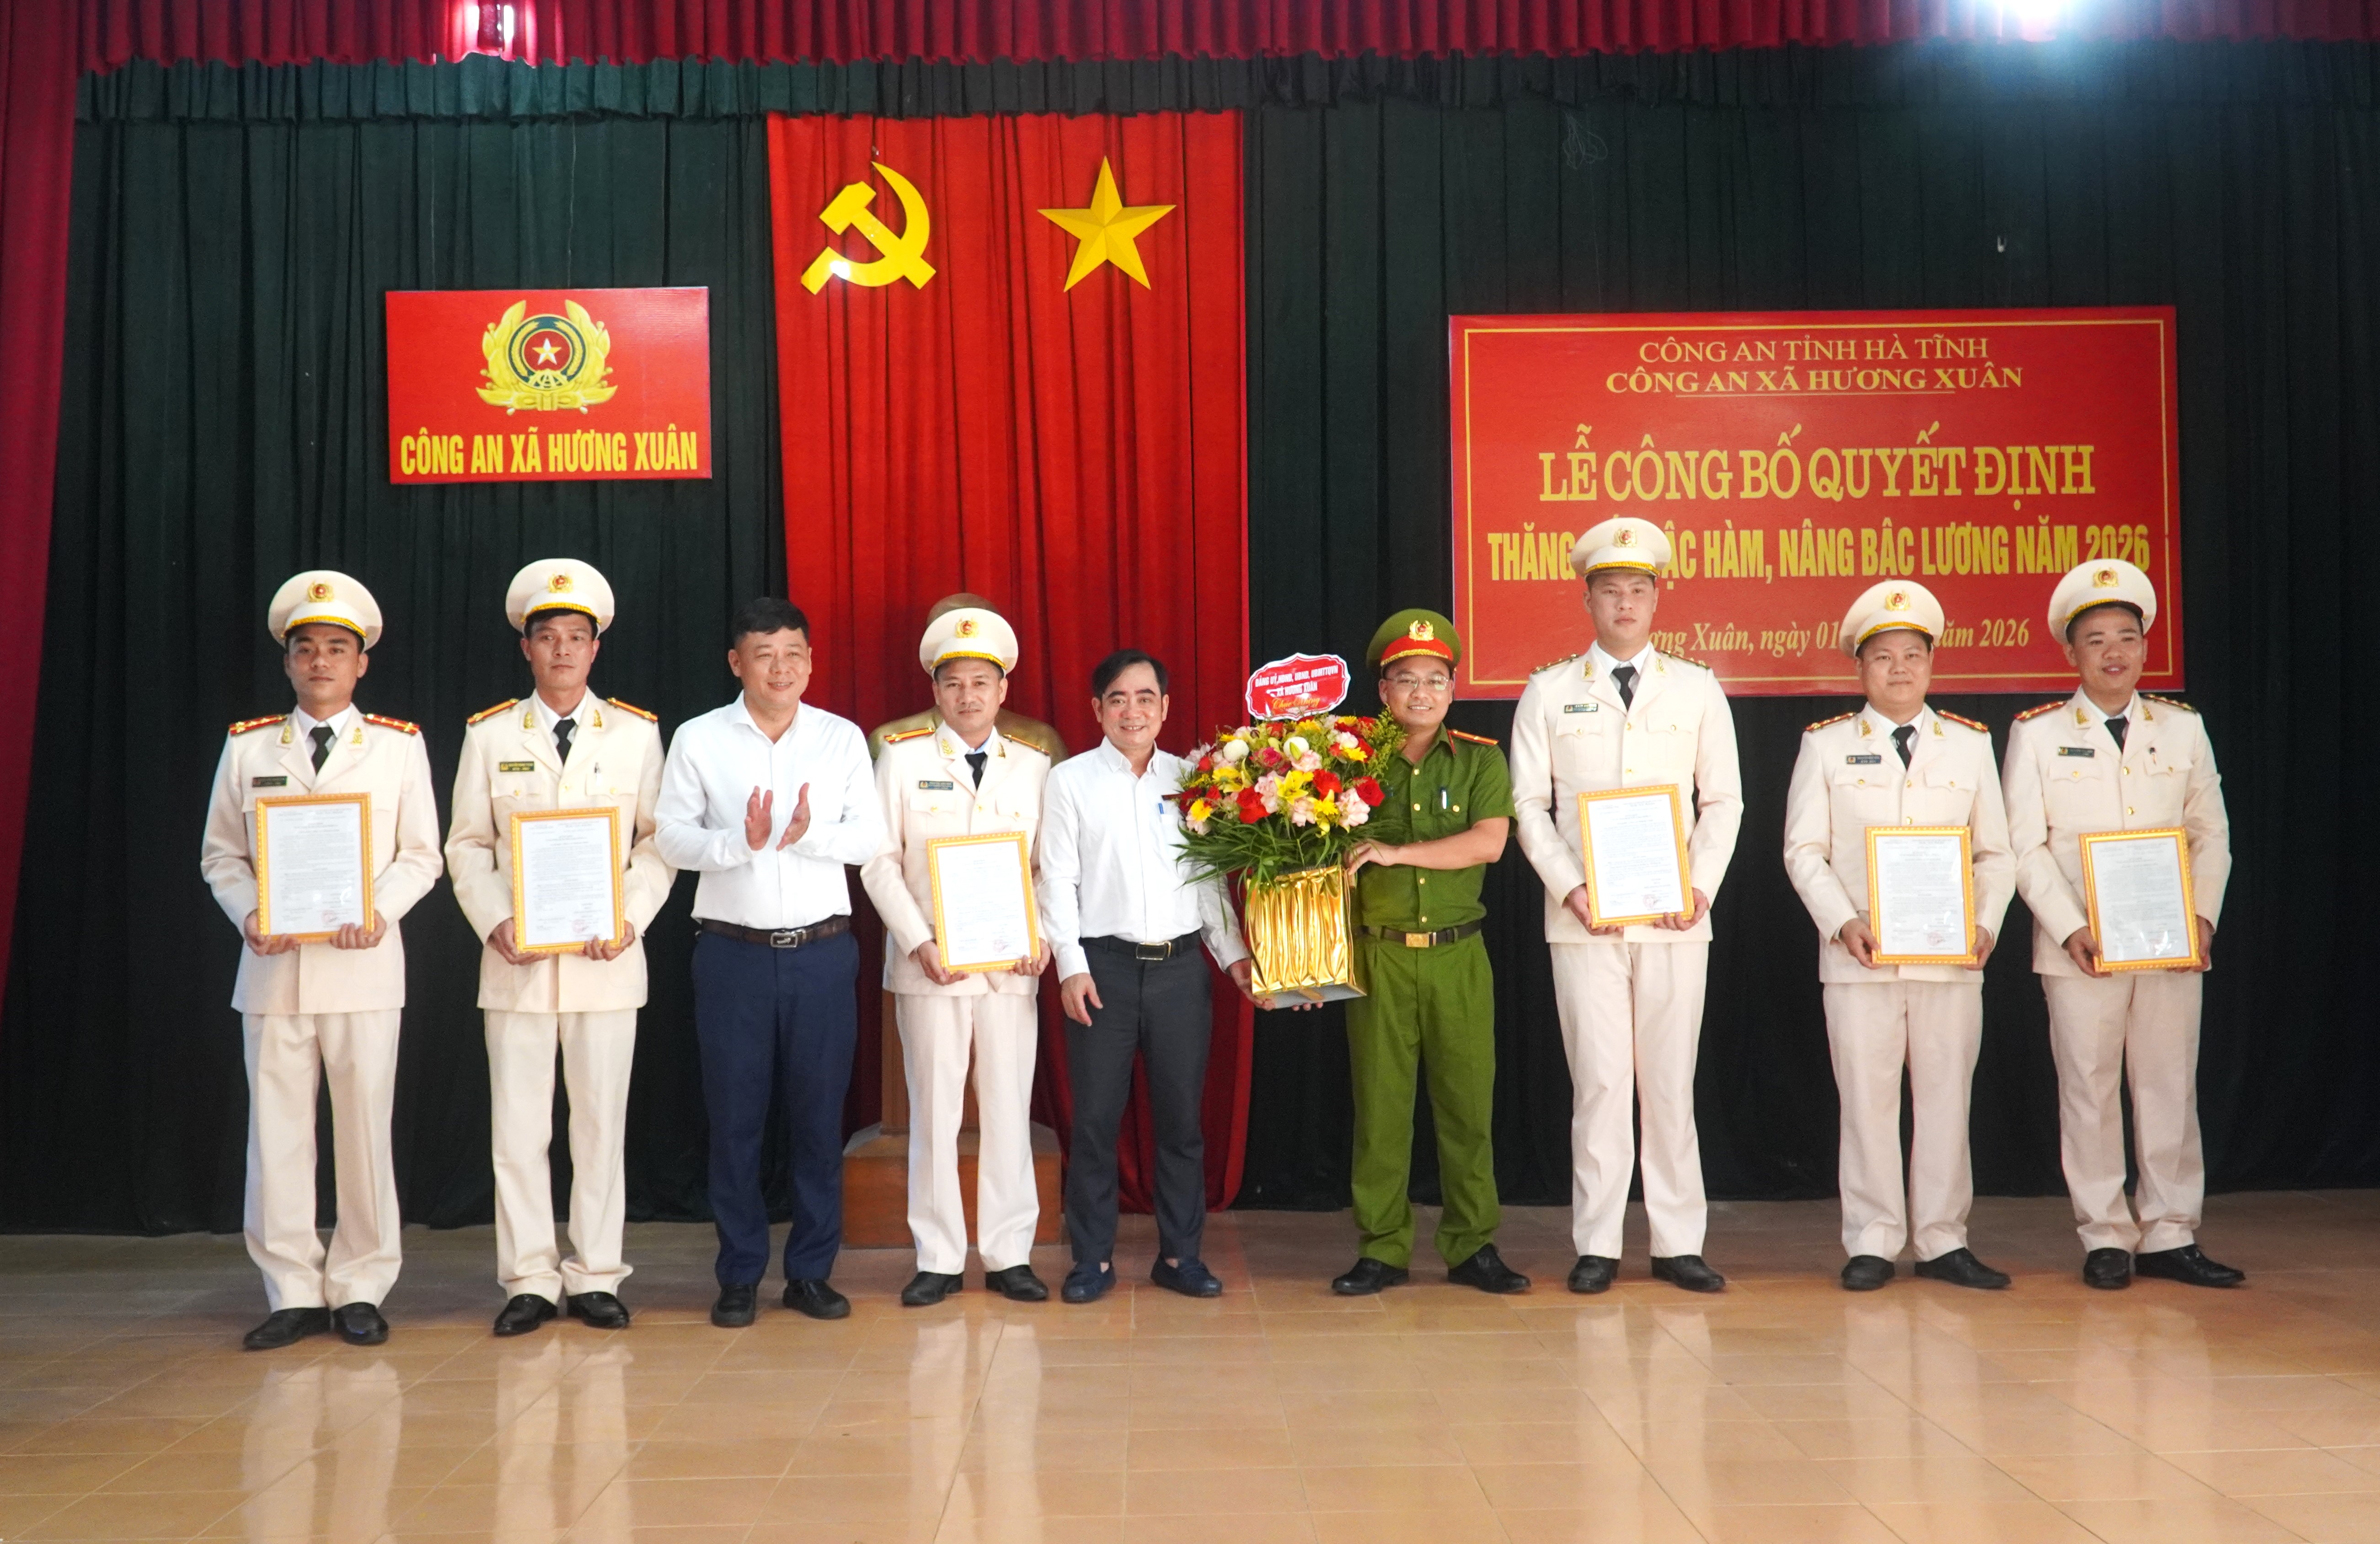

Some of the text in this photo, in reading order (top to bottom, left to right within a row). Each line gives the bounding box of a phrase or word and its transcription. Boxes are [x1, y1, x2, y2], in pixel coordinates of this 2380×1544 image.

[1640, 333, 1989, 363] CÔNG AN TỈNH HÀ TĨNH
[1606, 361, 2023, 393] CÔNG AN XÃ HƯƠNG XUÂN
[401, 423, 697, 475] CÔNG AN XÃ HƯƠNG XUÂN
[1539, 421, 2096, 511] LỄ CÔNG BỐ QUYẾT ĐỊNH
[1487, 522, 1576, 580] THĂNG
[1662, 520, 1696, 590] ẬC
[1704, 519, 1772, 584] HÀM,
[1779, 518, 1855, 577] NÂNG
[1921, 521, 2009, 575] LƯƠNG
[2015, 515, 2078, 574] NĂM
[2086, 525, 2150, 573] 2026
[1648, 618, 2030, 658] ơng Xuân, ngày 01 ăm 2026
